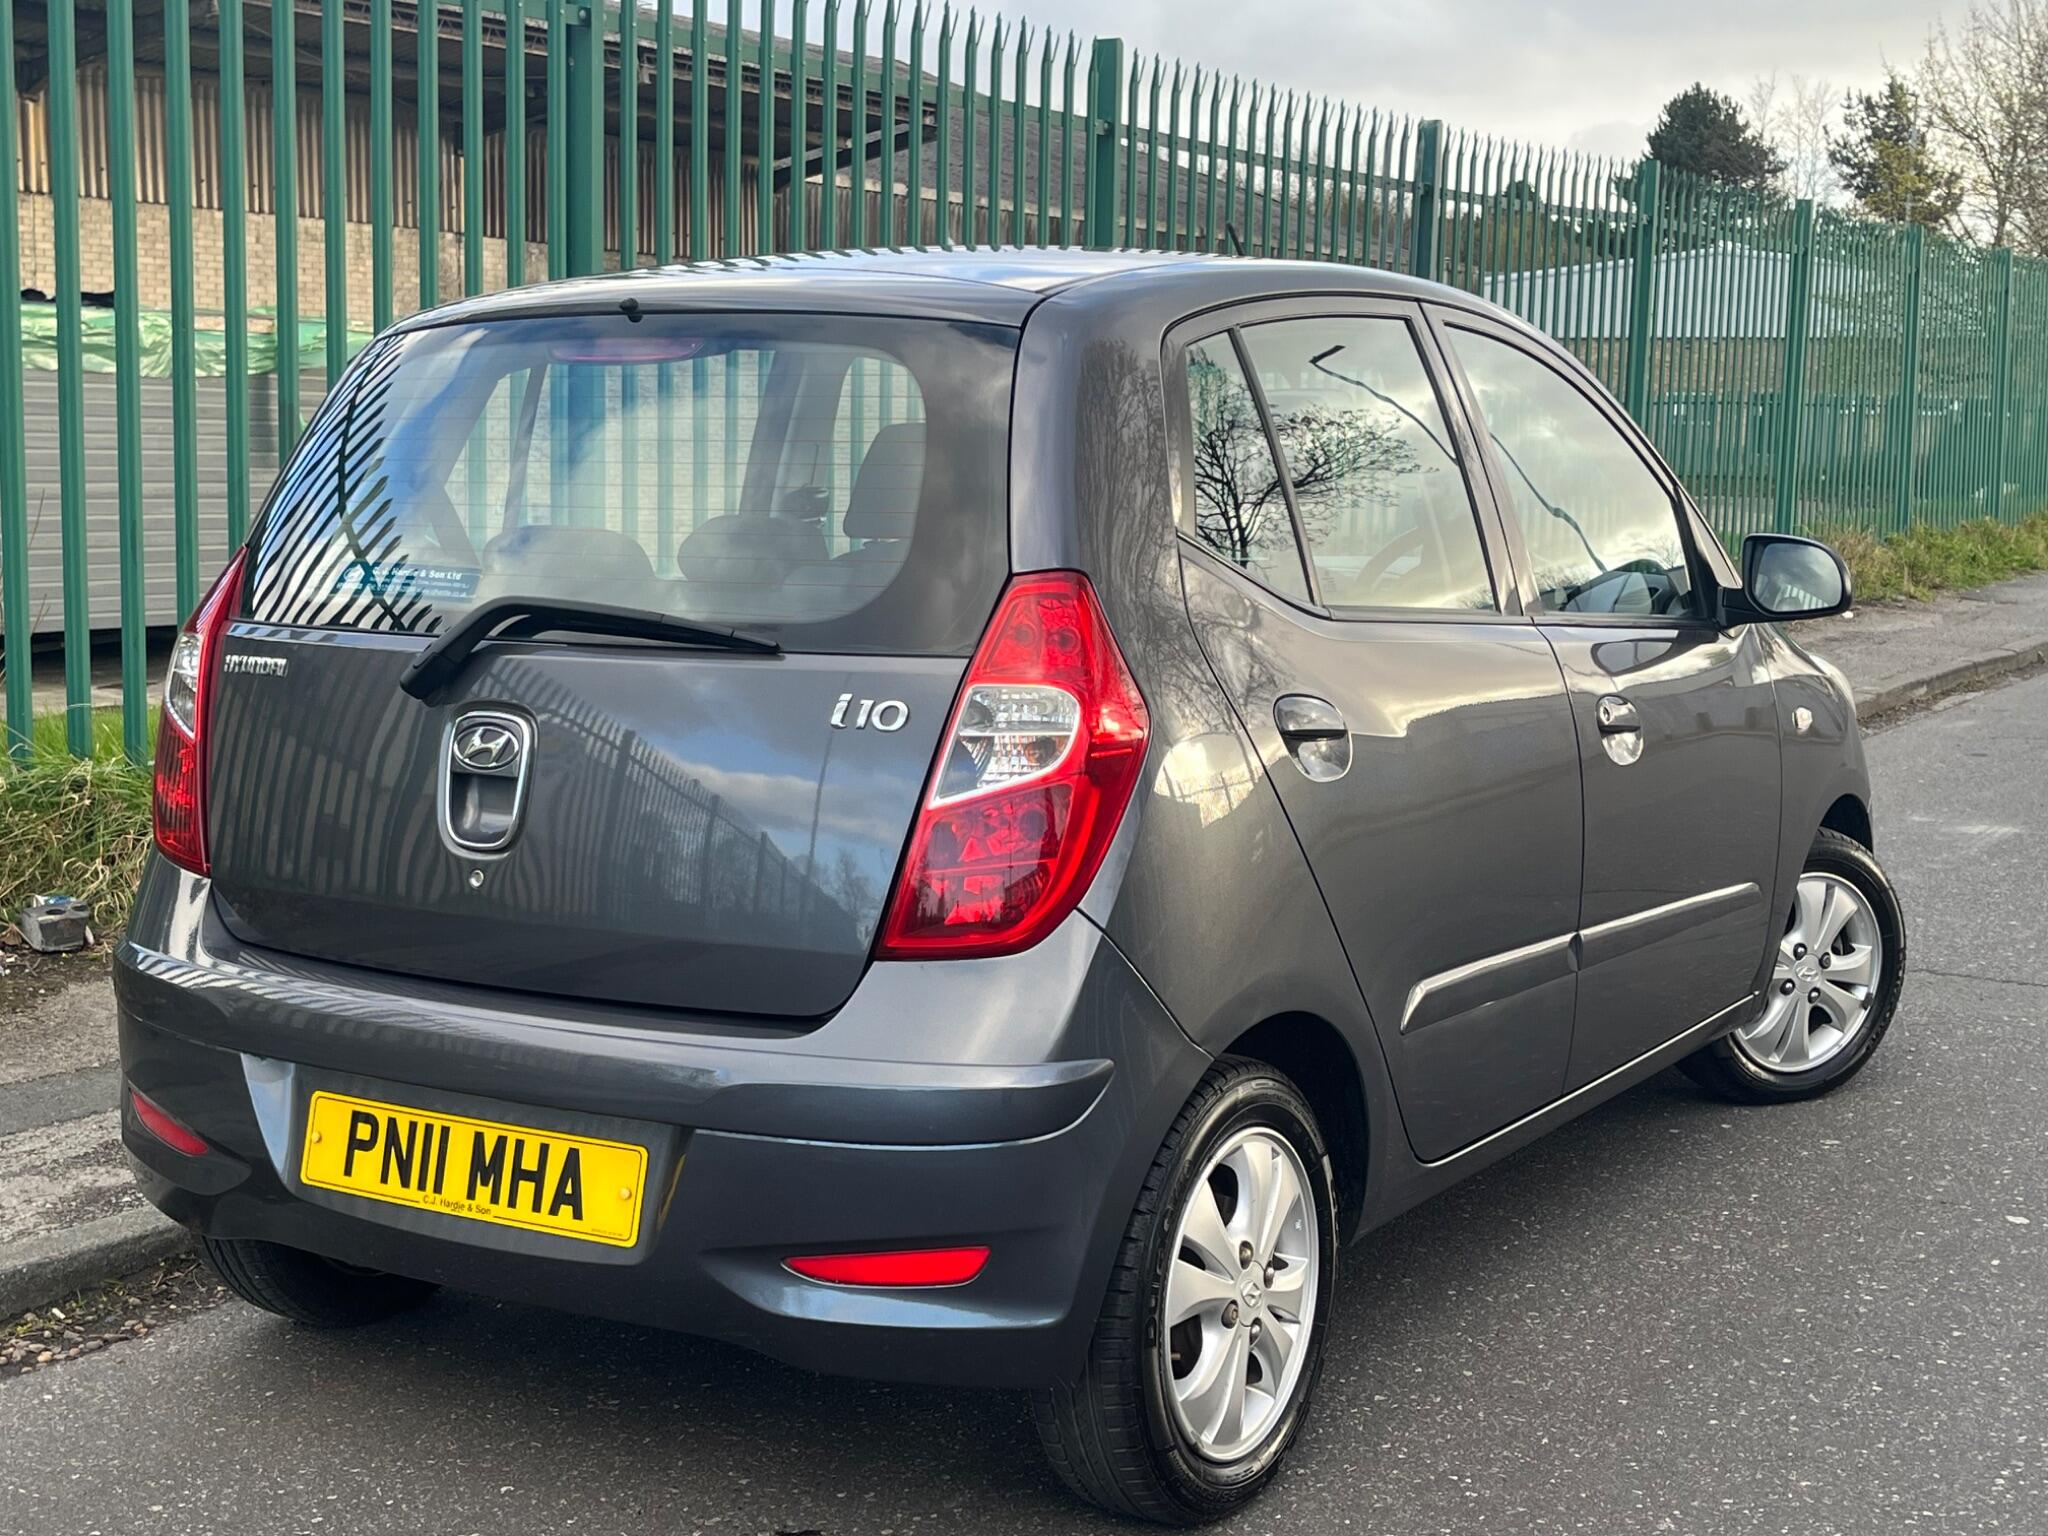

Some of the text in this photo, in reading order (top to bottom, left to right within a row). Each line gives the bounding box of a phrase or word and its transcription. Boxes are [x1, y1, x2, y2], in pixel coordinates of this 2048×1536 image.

[419, 569, 428, 577] &
[430, 570, 446, 579] Son
[447, 571, 463, 581] Ltd
[830, 693, 908, 731] i10
[343, 1110, 583, 1221] PN11 MHA
[467, 1203, 473, 1213] &
[475, 1204, 491, 1215] Son
